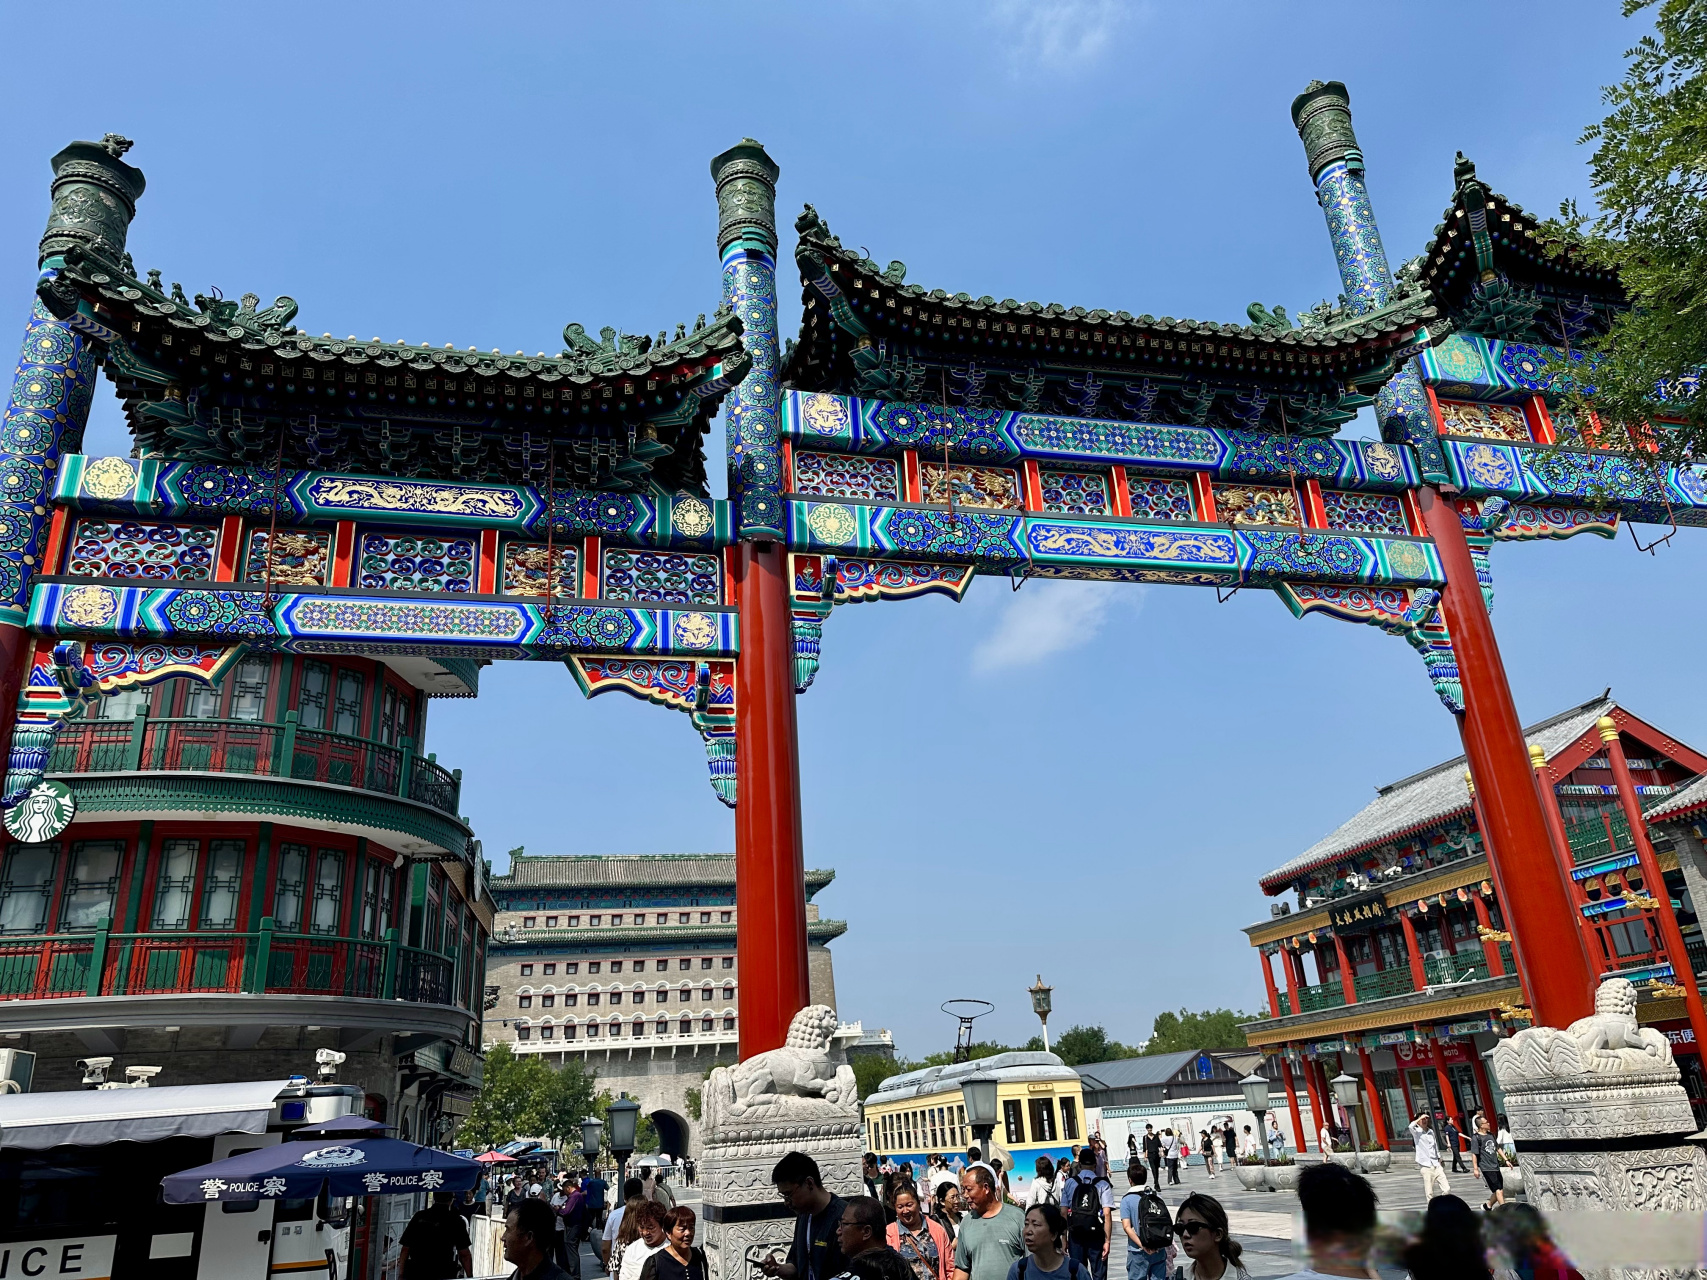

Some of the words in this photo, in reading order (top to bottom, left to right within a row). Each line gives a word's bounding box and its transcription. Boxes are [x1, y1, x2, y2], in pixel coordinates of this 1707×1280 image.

[1662, 1028, 1697, 1044] 东便
[200, 1178, 228, 1199] 警
[229, 1182, 260, 1193] POLICE
[260, 1176, 287, 1197] 察
[362, 1172, 389, 1192] 警
[390, 1175, 418, 1186] POLICE
[418, 1170, 444, 1189] 察
